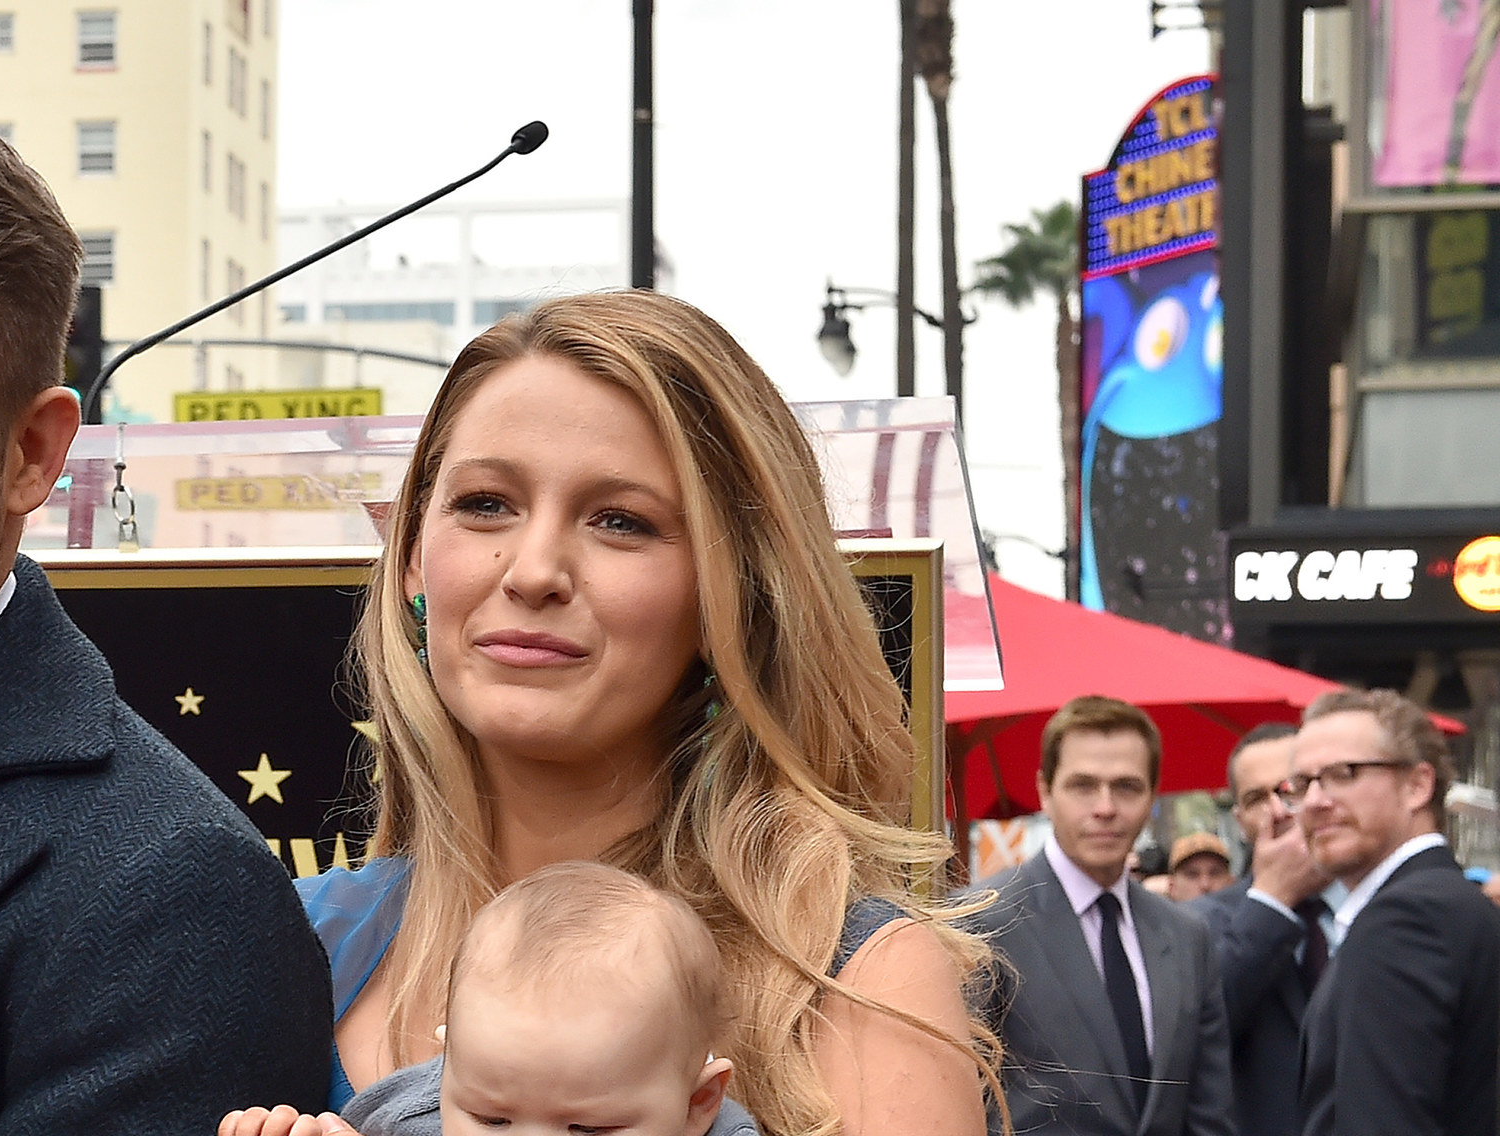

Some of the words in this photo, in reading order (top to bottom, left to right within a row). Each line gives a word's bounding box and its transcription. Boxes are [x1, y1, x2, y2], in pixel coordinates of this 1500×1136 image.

[1151, 93, 1206, 141] TCL
[190, 400, 263, 422] PED
[282, 397, 366, 419] XING
[191, 482, 263, 504] PED
[1297, 549, 1419, 600] CAFE
